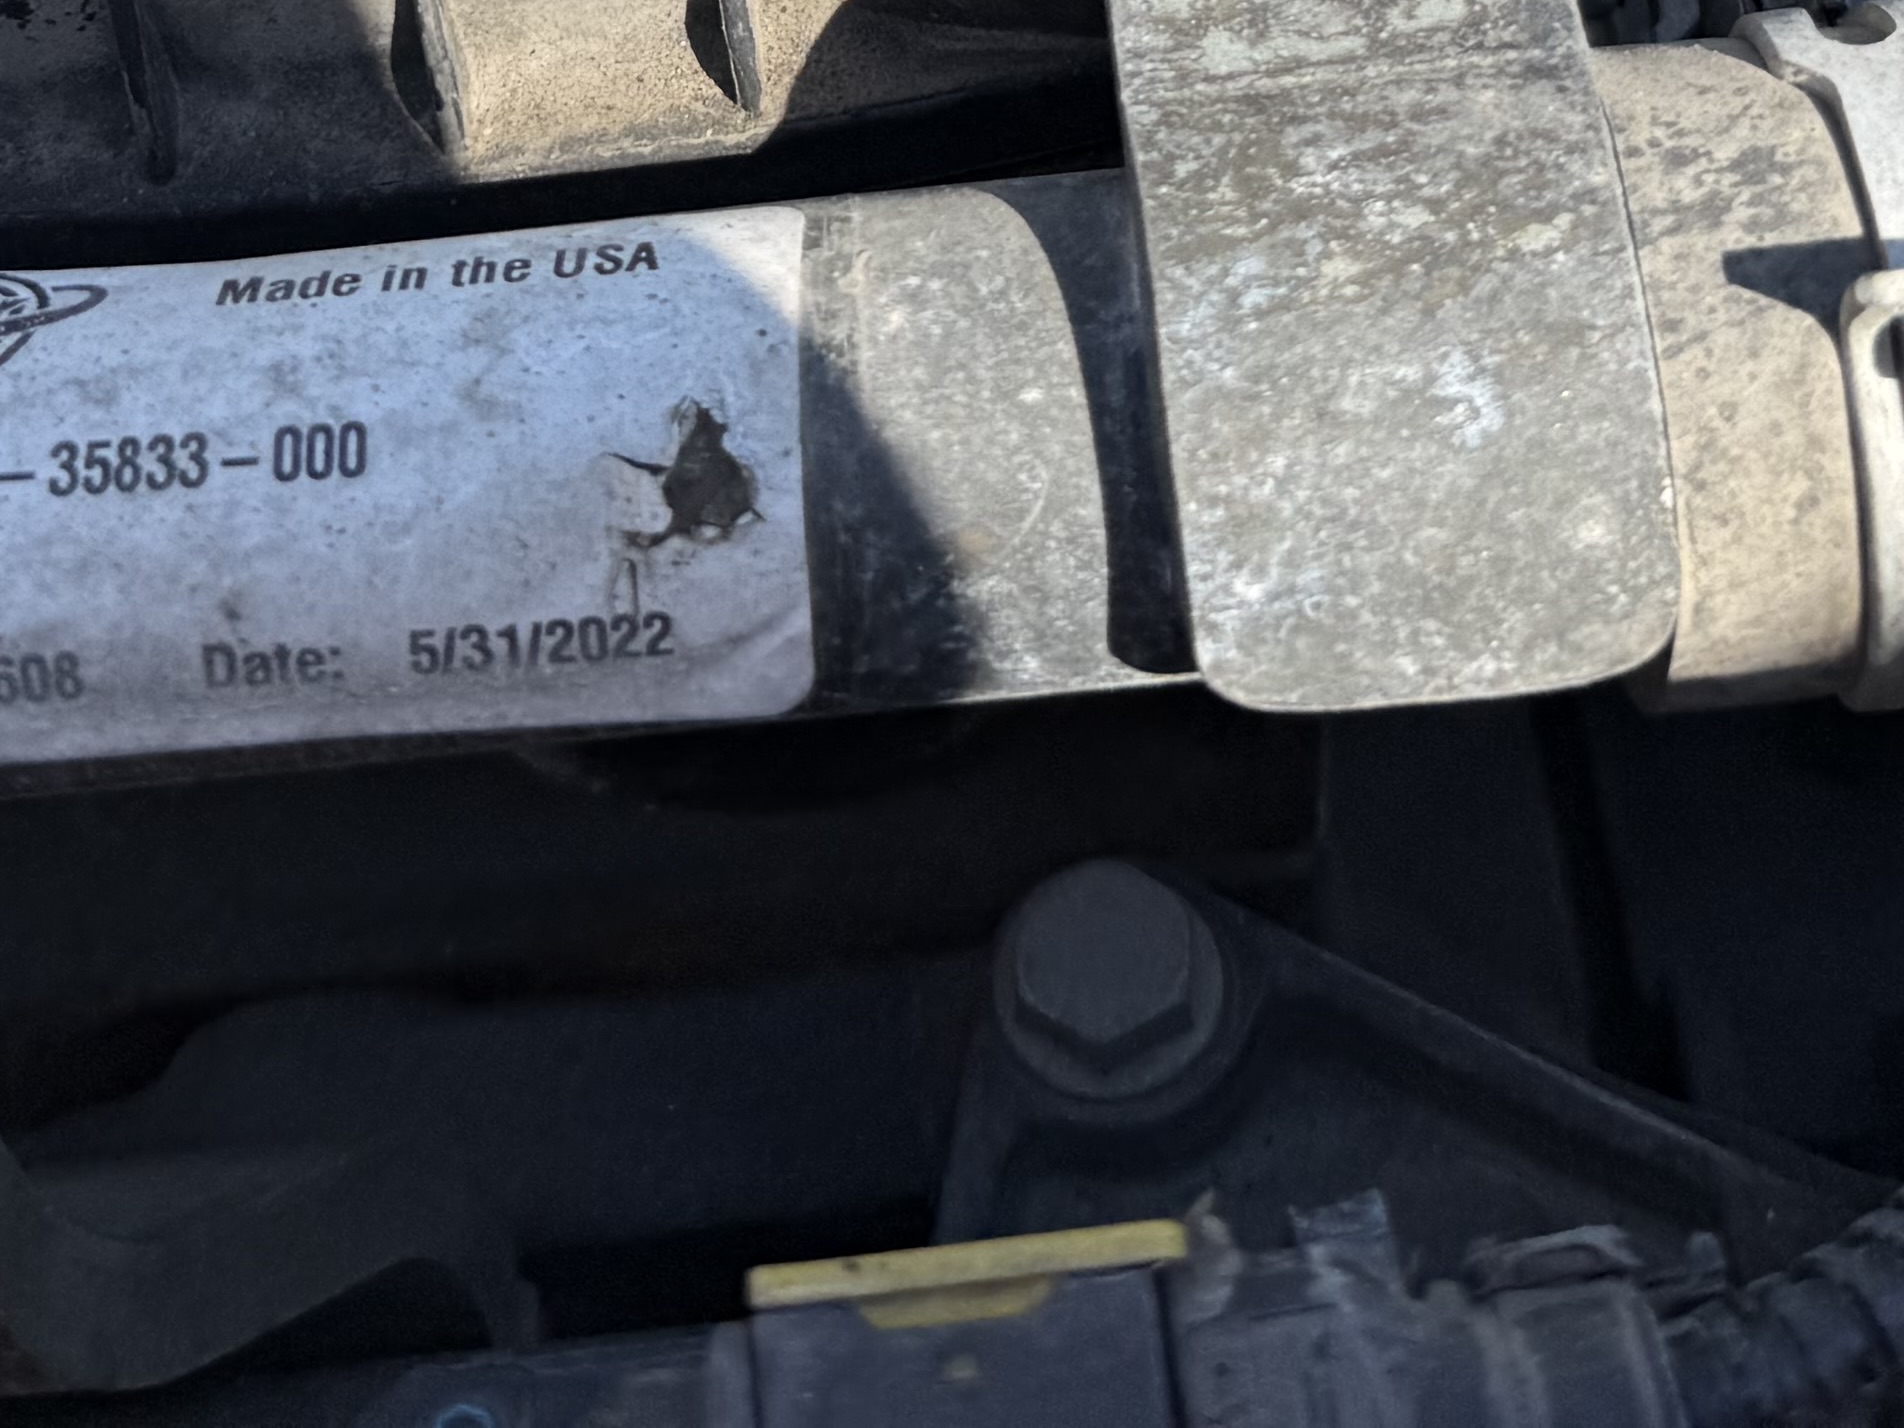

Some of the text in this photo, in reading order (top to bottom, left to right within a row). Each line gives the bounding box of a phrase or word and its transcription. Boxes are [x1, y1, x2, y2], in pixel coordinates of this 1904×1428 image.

[215, 241, 660, 306] Made in the USA
[202, 643, 344, 688] Date:
[408, 611, 675, 675] 5/31/2022
